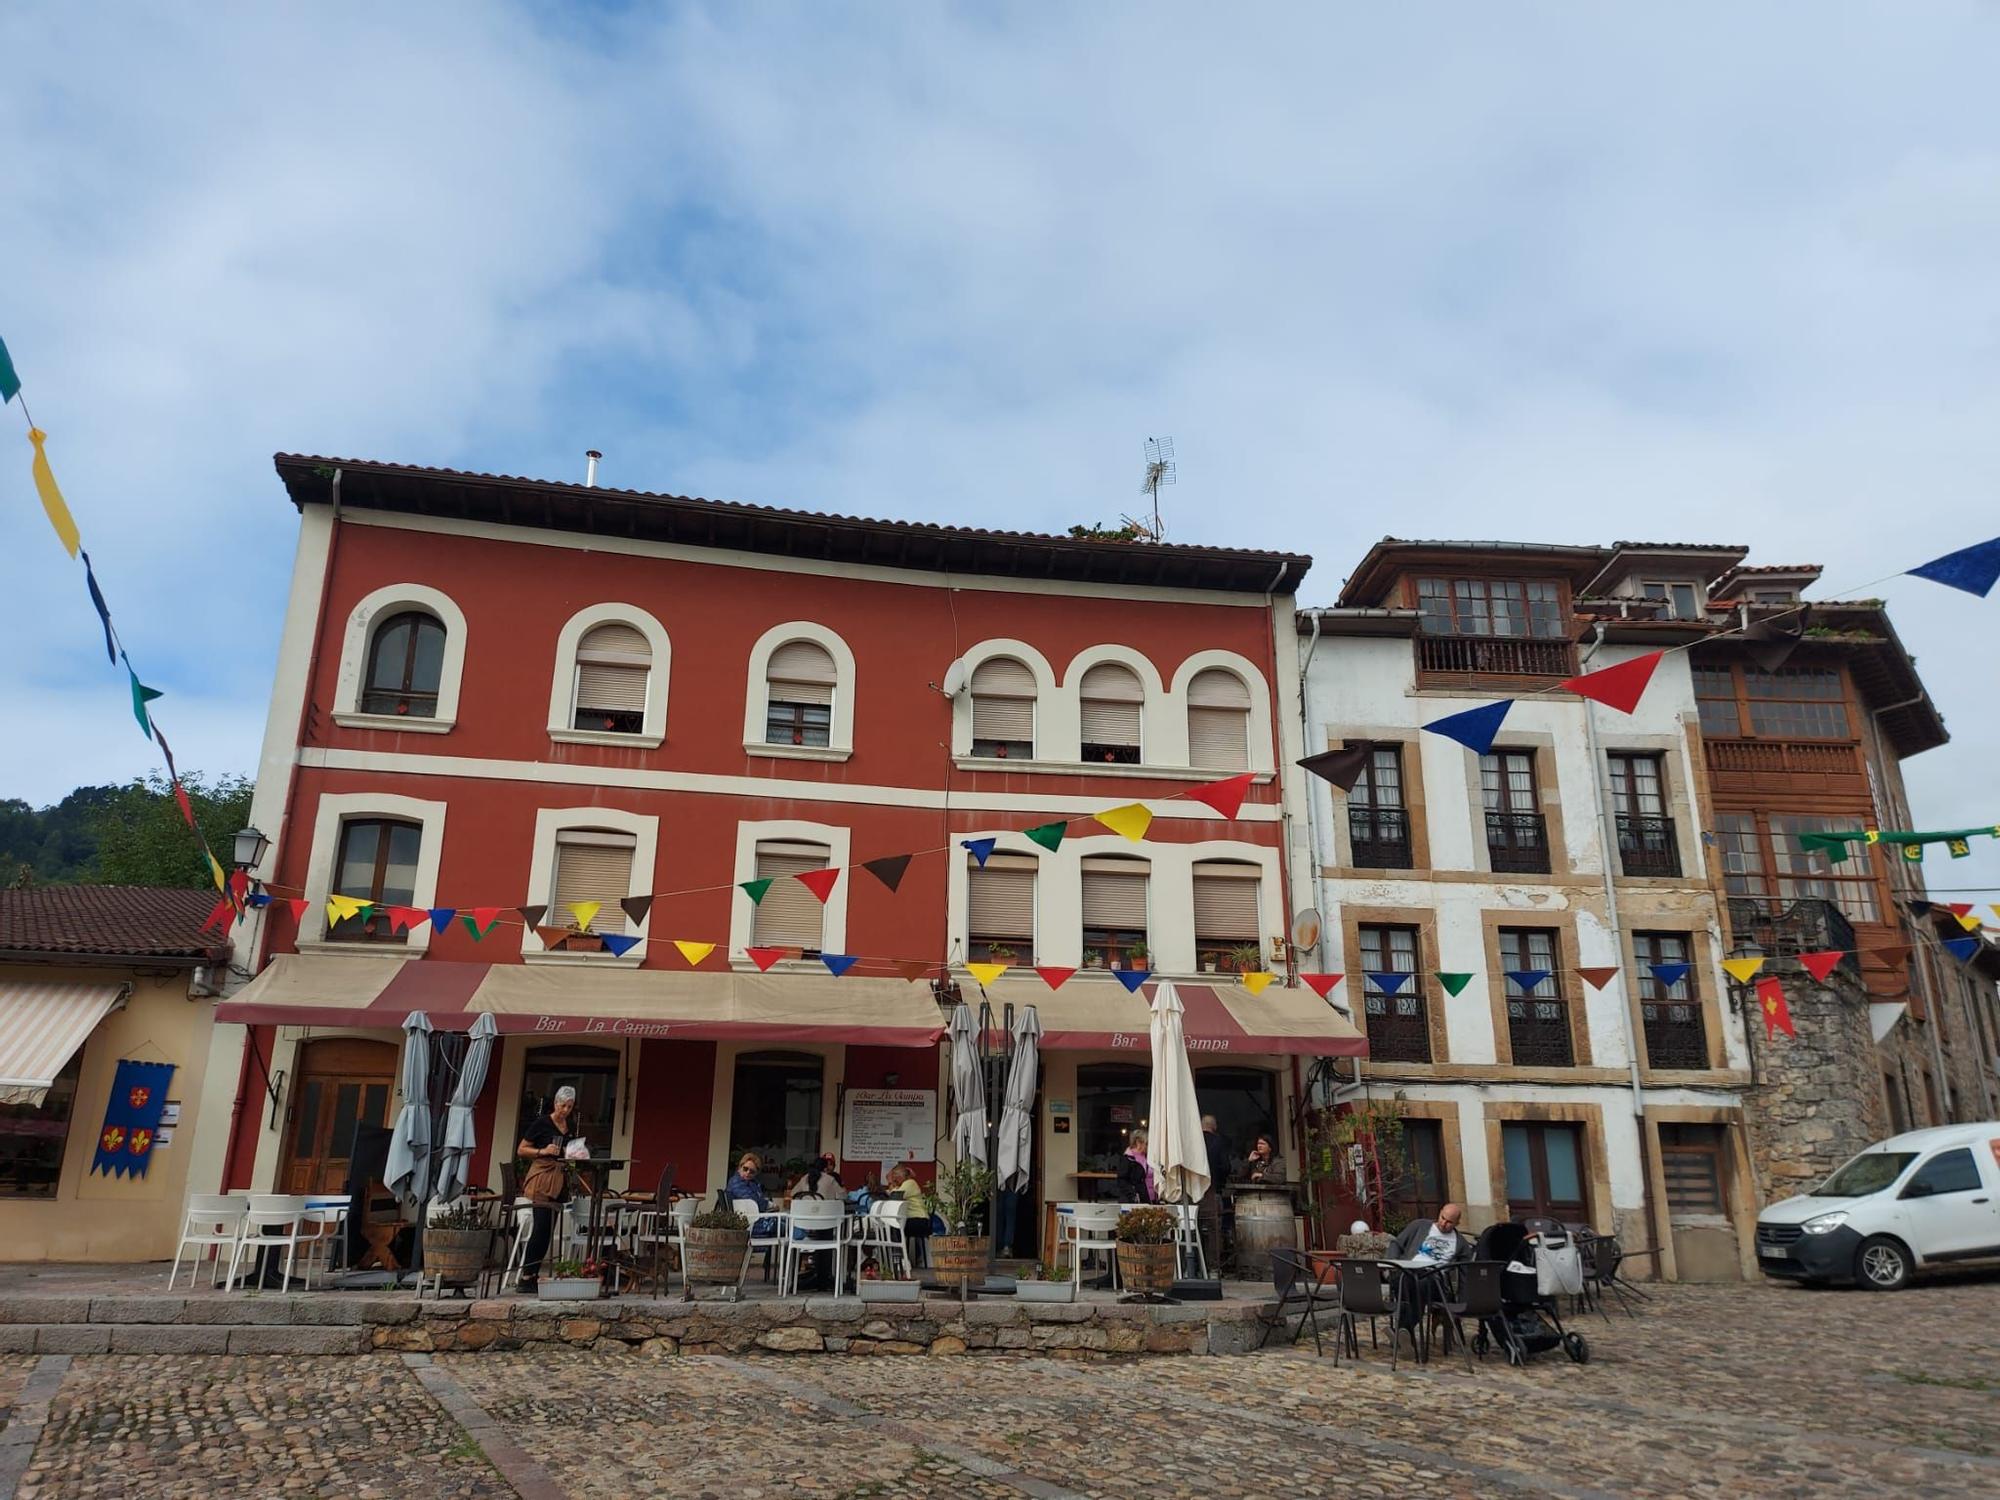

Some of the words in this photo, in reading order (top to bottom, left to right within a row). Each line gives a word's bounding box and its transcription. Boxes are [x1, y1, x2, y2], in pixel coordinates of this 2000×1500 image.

[535, 1015, 566, 1032] Bar
[584, 1018, 605, 1033] La
[612, 1018, 669, 1036] Campa
[1111, 1032, 1138, 1048] Bar
